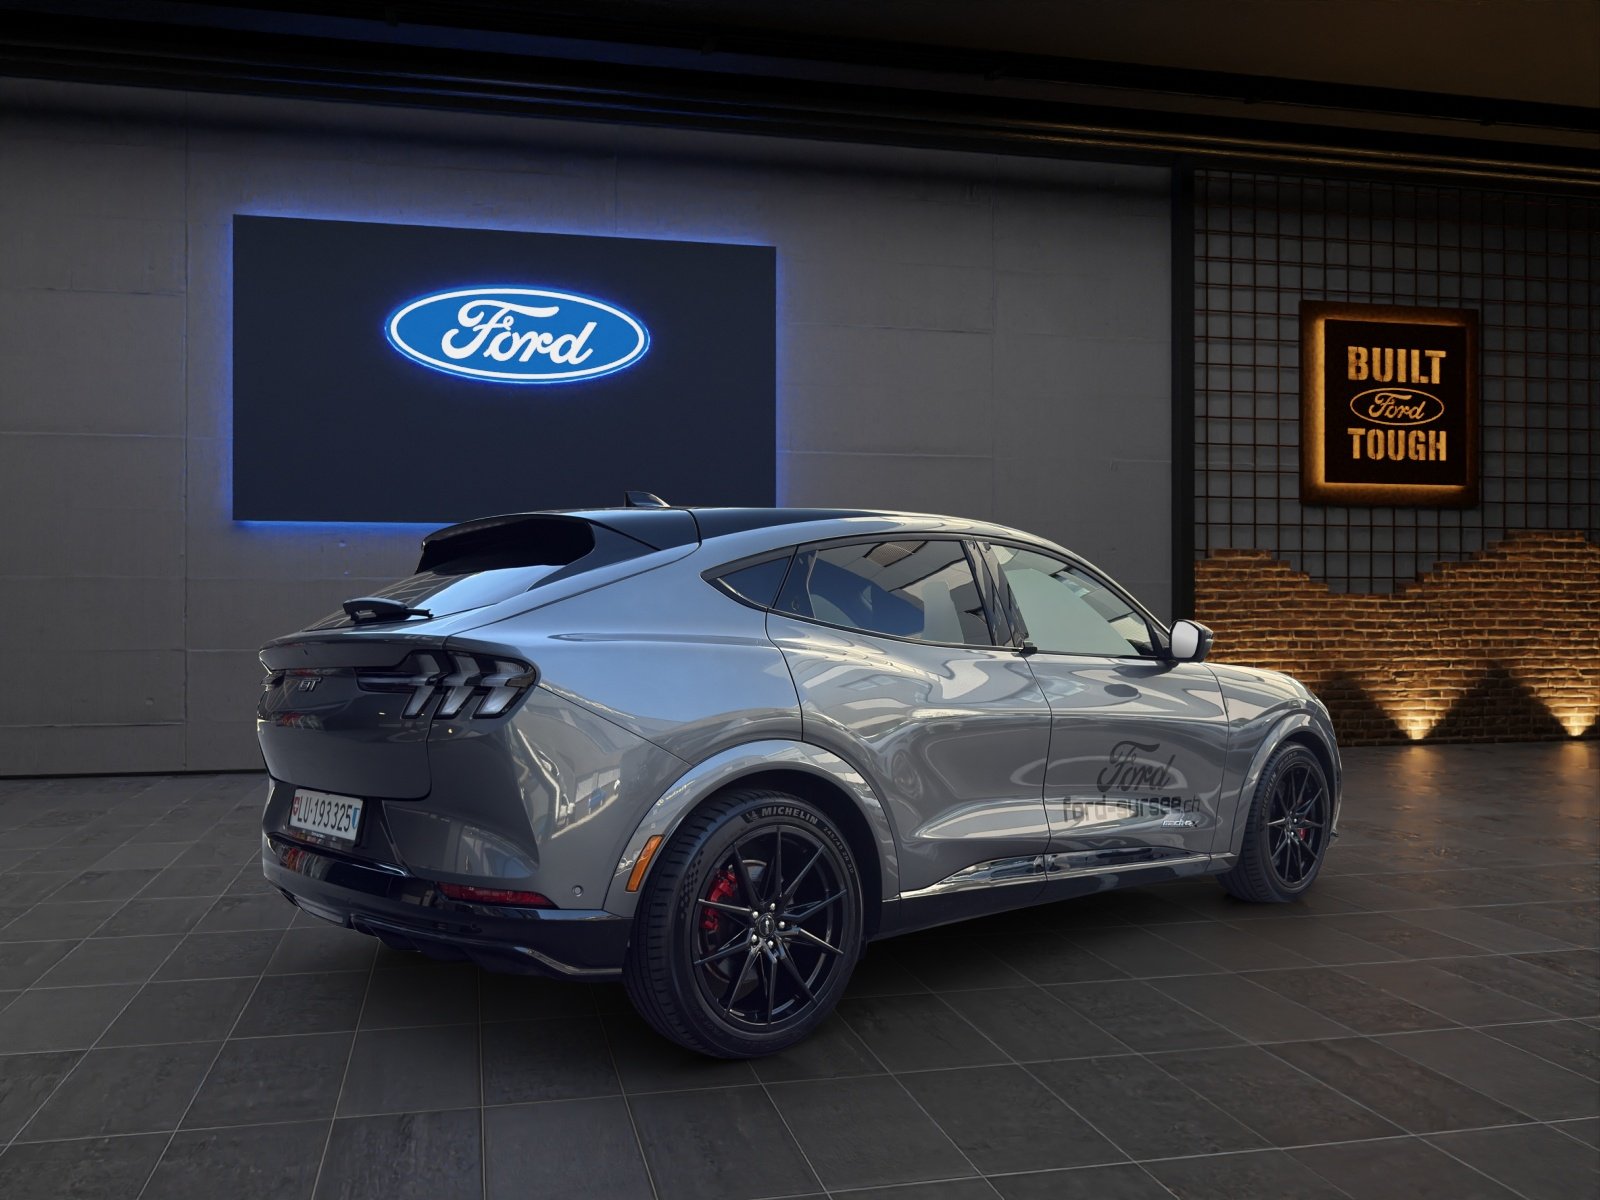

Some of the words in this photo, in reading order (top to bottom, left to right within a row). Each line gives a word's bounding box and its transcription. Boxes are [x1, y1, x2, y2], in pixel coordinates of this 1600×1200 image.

[441, 299, 598, 365] Ford
[1347, 345, 1447, 385] BUILT
[1368, 392, 1427, 420] Ford
[1347, 427, 1447, 462] TOUGH
[1096, 740, 1176, 793] Ford
[761, 806, 818, 825] MICHELIN
[1062, 792, 1201, 823] ford-sursee.ch
